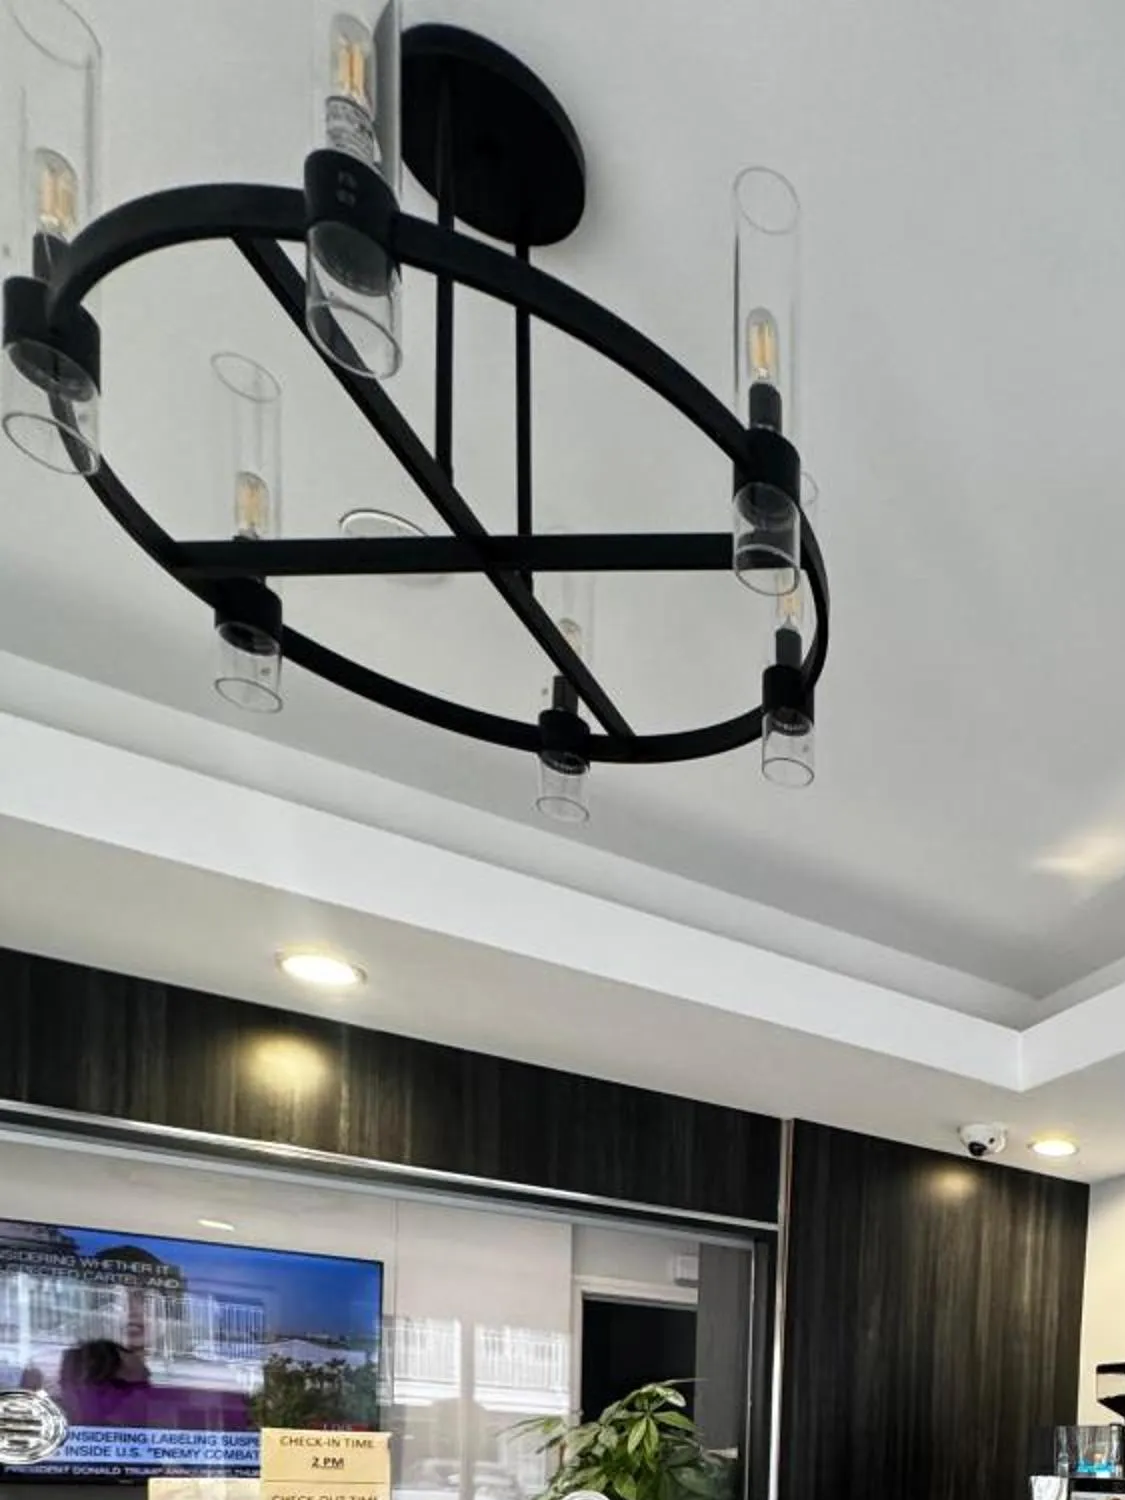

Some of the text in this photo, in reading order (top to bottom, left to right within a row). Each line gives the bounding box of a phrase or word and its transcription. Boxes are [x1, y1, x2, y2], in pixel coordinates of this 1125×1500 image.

[151, 1432, 218, 1447] LABELING
[344, 1438, 375, 1449] TIME
[65, 1446, 112, 1459] INSIDE
[311, 1456, 345, 1469] 2 PM
[72, 1466, 122, 1477] DONALD
